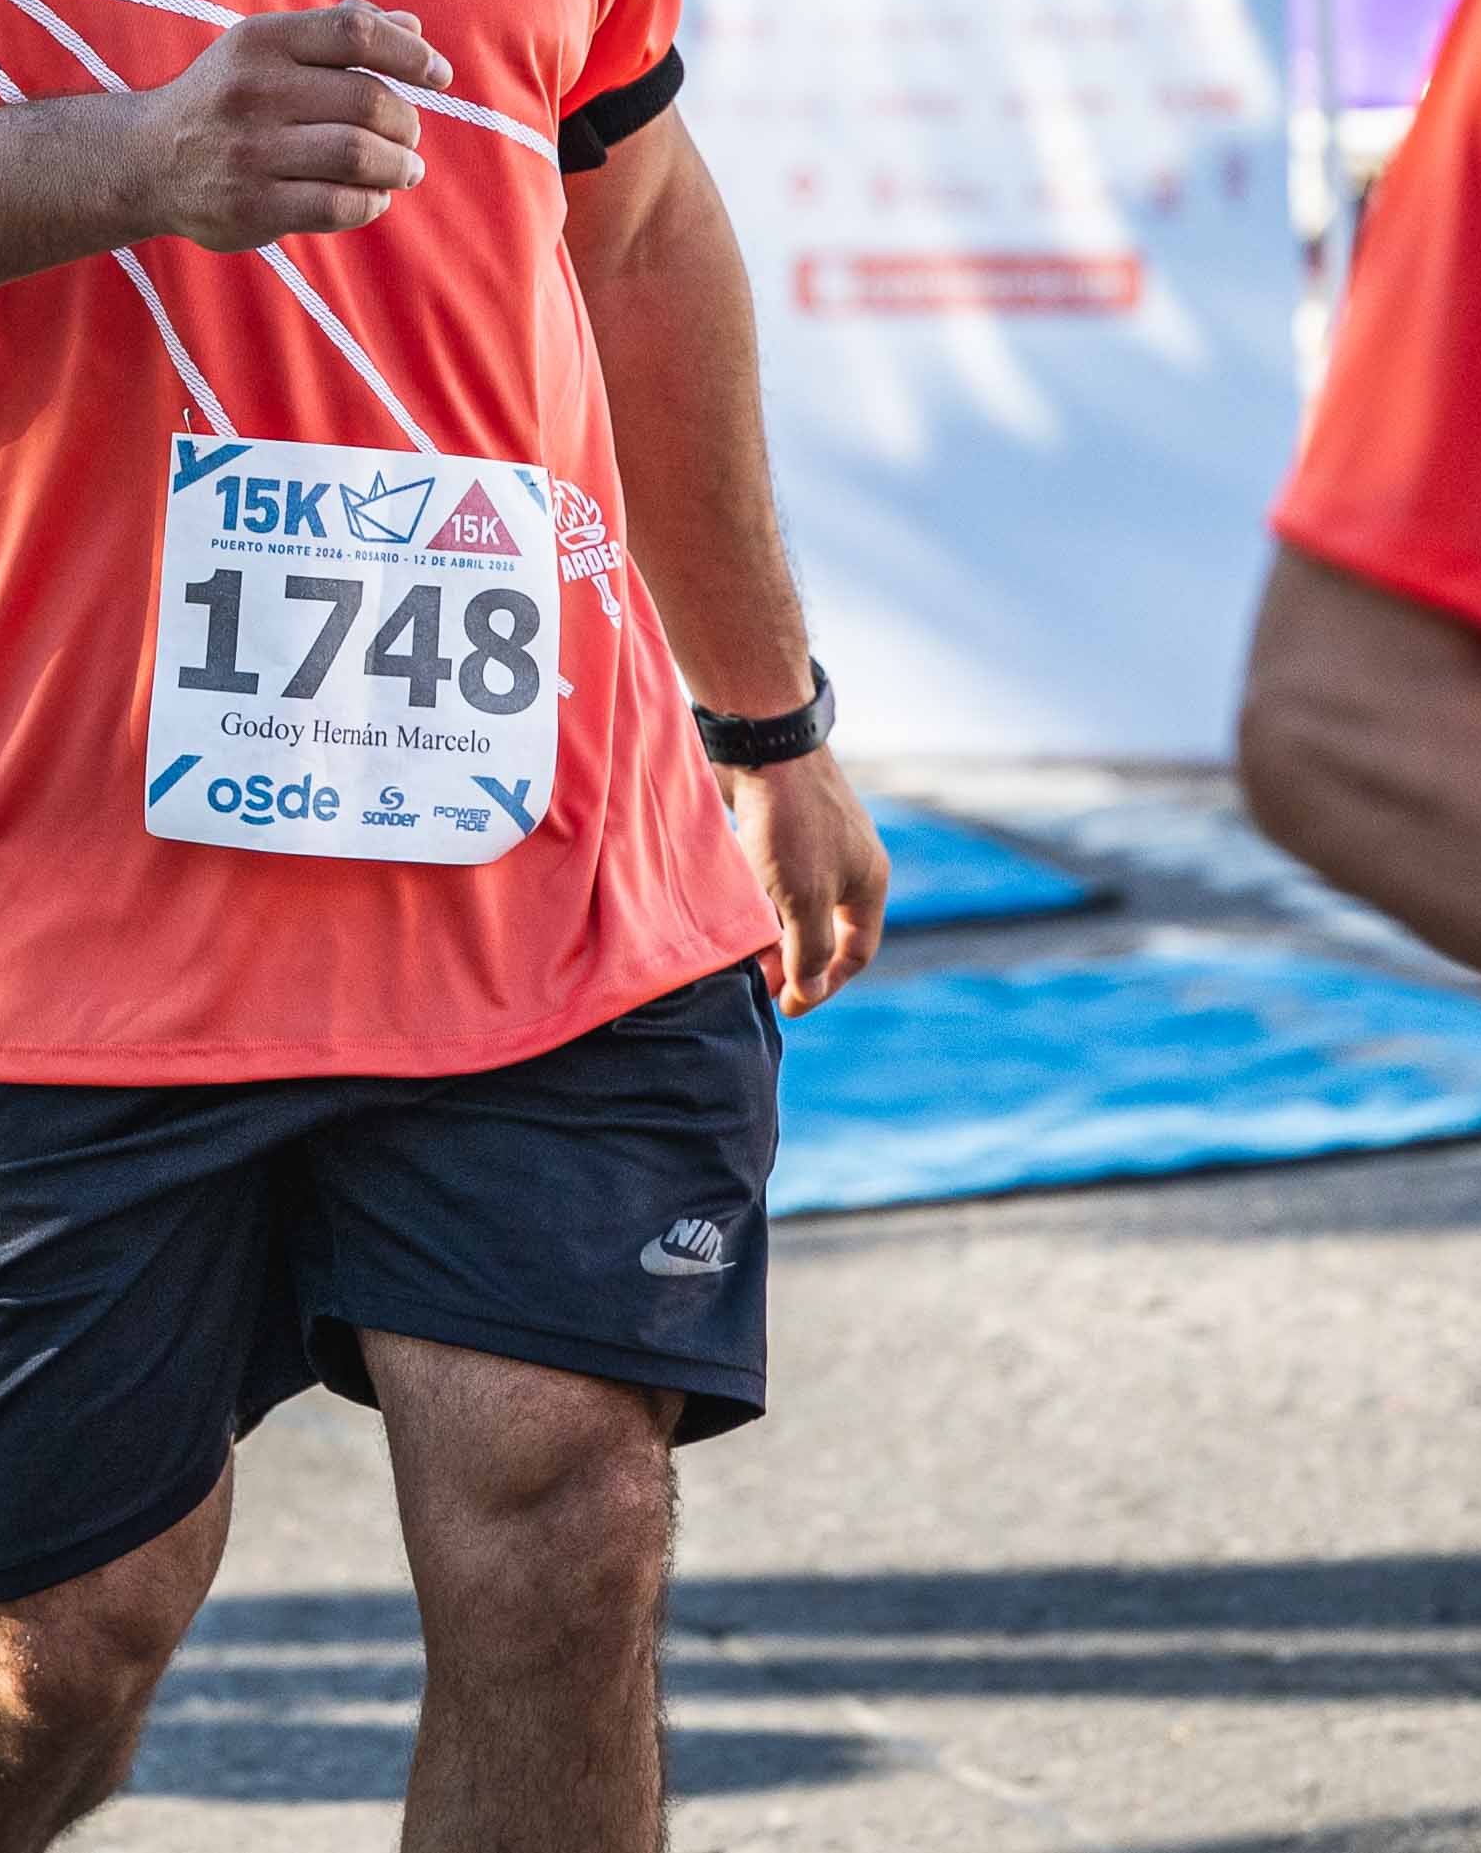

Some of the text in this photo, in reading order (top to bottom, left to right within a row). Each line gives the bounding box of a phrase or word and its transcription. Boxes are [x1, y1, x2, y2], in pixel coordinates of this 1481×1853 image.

[215, 475, 331, 539] 15K
[450, 513, 500, 545] 15K
[211, 538, 263, 553] PUERTO
[268, 543, 312, 557] NORTE
[315, 548, 343, 560] 2026
[355, 550, 399, 564] ROSARIO
[413, 555, 427, 565] 12
[432, 555, 446, 567] DE
[451, 558, 484, 570] ABRIL
[489, 560, 516, 572] 2026
[178, 568, 540, 716] 1748
[220, 712, 491, 753] Godoy Hernán Marcelo
[207, 772, 340, 824] osde
[433, 805, 491, 821] POWER
